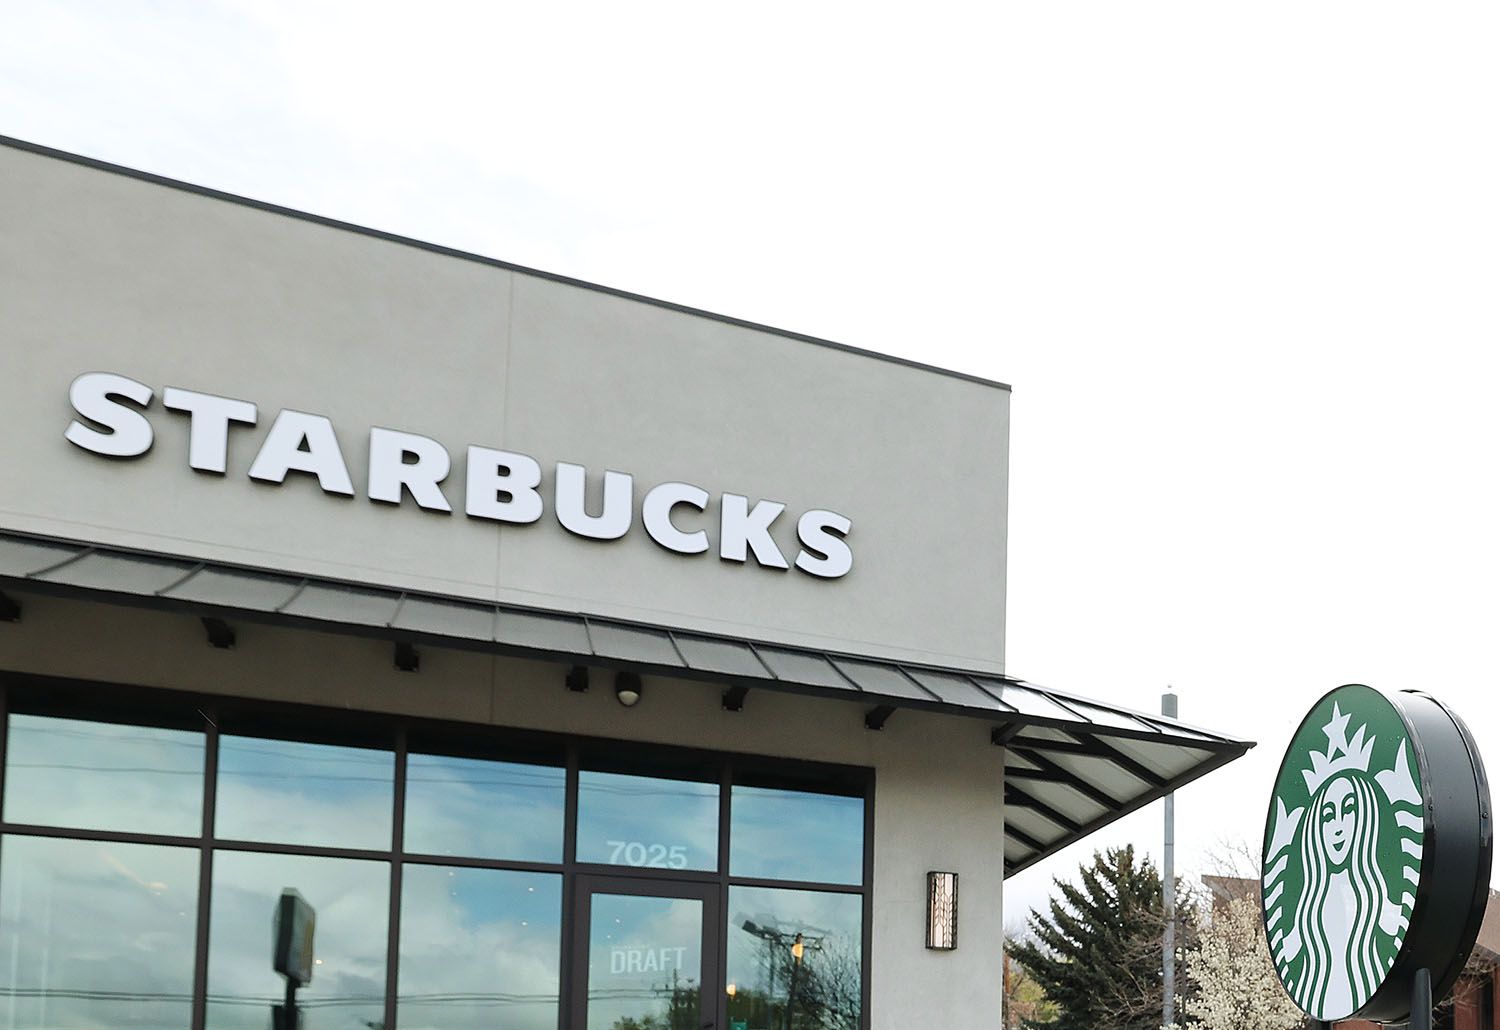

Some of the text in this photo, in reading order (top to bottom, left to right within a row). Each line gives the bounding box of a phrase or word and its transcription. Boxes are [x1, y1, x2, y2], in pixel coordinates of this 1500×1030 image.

[64, 371, 853, 578] STARBUCKS
[606, 840, 688, 869] 7025
[610, 946, 688, 974] DRAFT
